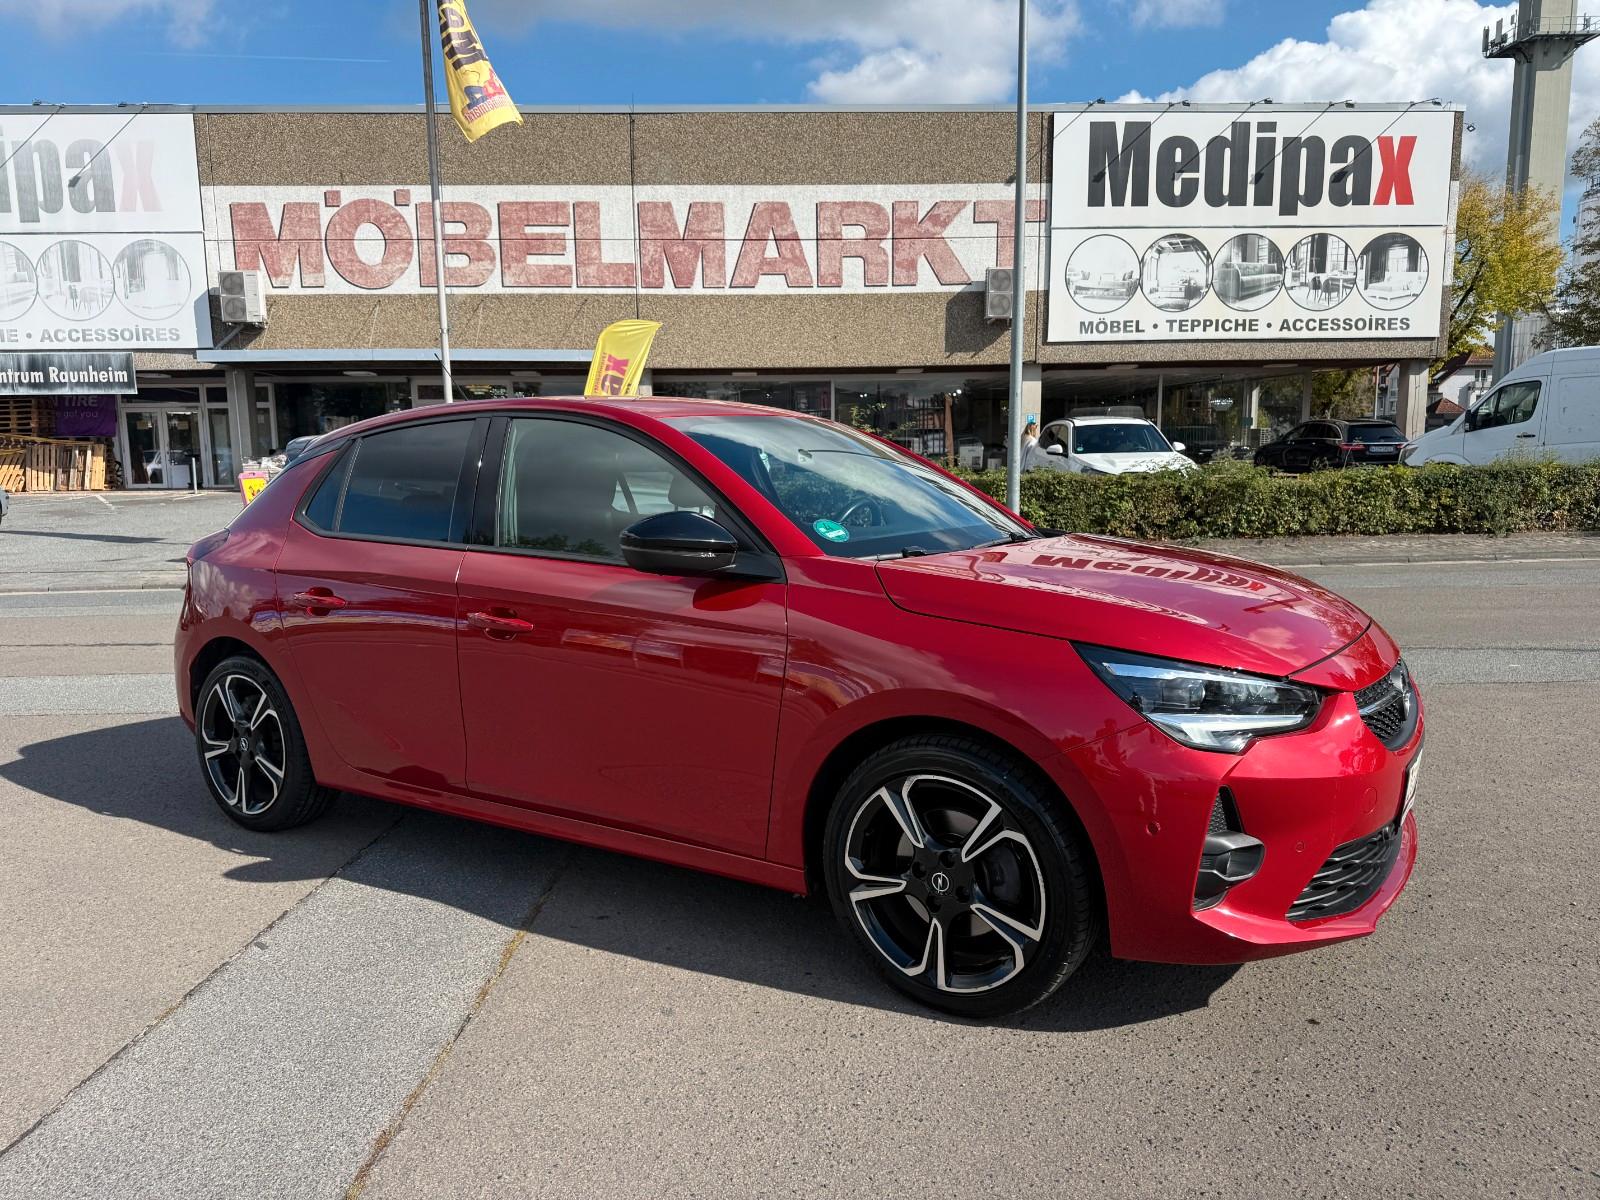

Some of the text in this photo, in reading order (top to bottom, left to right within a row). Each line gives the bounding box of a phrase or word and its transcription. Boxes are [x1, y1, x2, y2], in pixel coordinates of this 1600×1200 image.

[1087, 121, 1418, 216] Medipax
[229, 188, 1048, 290] MÖBELMARKT
[1079, 318, 1145, 334] MÖBEL
[1165, 318, 1259, 333] TEPPICHE
[0, 365, 128, 383] ntrum Raunheim
